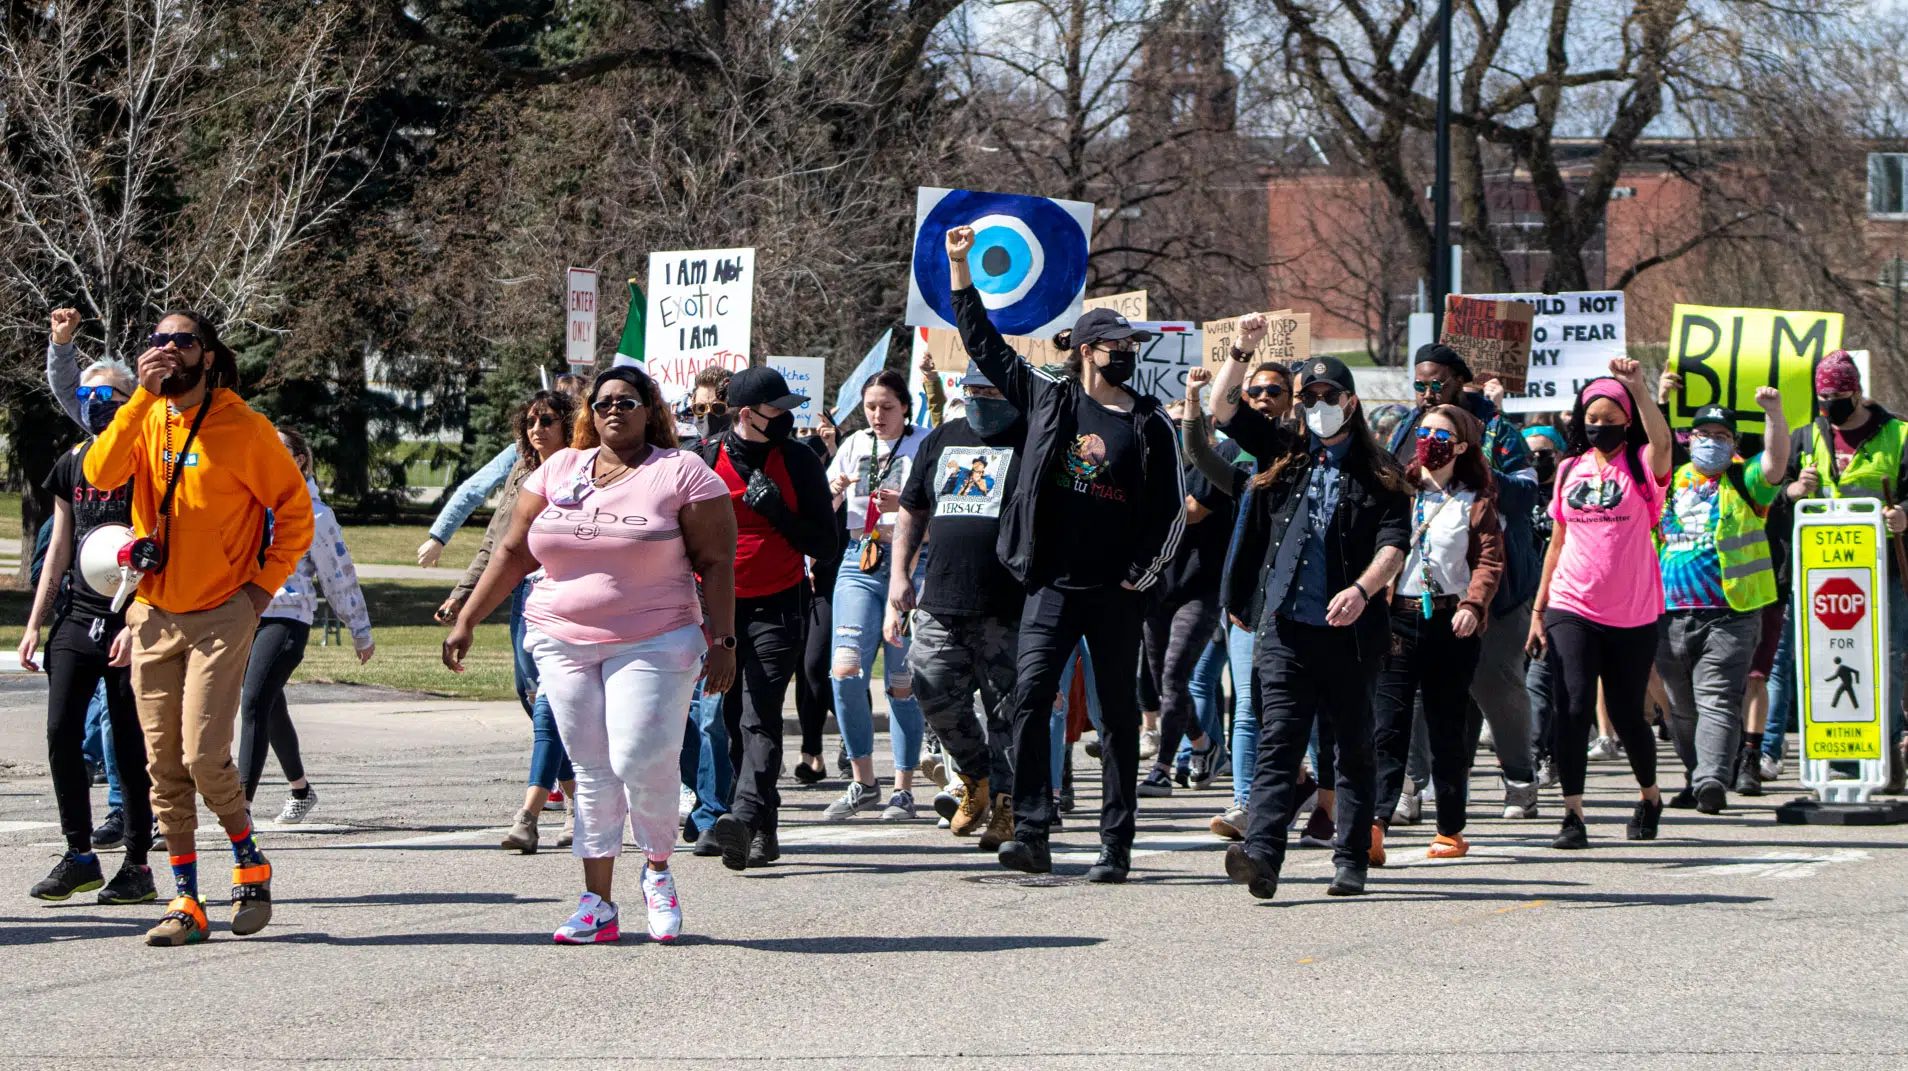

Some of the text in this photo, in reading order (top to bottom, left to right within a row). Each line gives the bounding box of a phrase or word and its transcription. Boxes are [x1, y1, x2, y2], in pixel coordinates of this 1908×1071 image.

[665, 263, 671, 284] I
[571, 290, 594, 313] ENTER
[1449, 296, 1496, 320] WHITE
[1579, 296, 1618, 313] NOT
[572, 320, 592, 342] ONLY
[1207, 319, 1297, 334] WHEN USED
[1562, 323, 1616, 341] FEAR
[679, 327, 685, 351] I
[1219, 336, 1231, 347] TO
[1270, 346, 1295, 358] FEELS
[1532, 348, 1560, 366] MY
[1677, 314, 1828, 422] BLM
[541, 507, 648, 526] bebe
[943, 503, 985, 515] VERSACE
[1815, 531, 1862, 545] STATE
[1823, 549, 1855, 562] LAW
[1815, 594, 1864, 615] STOP
[1829, 638, 1855, 649] FOR
[1825, 728, 1862, 737] WITHIN
[1813, 742, 1874, 753] CROSSWALK
